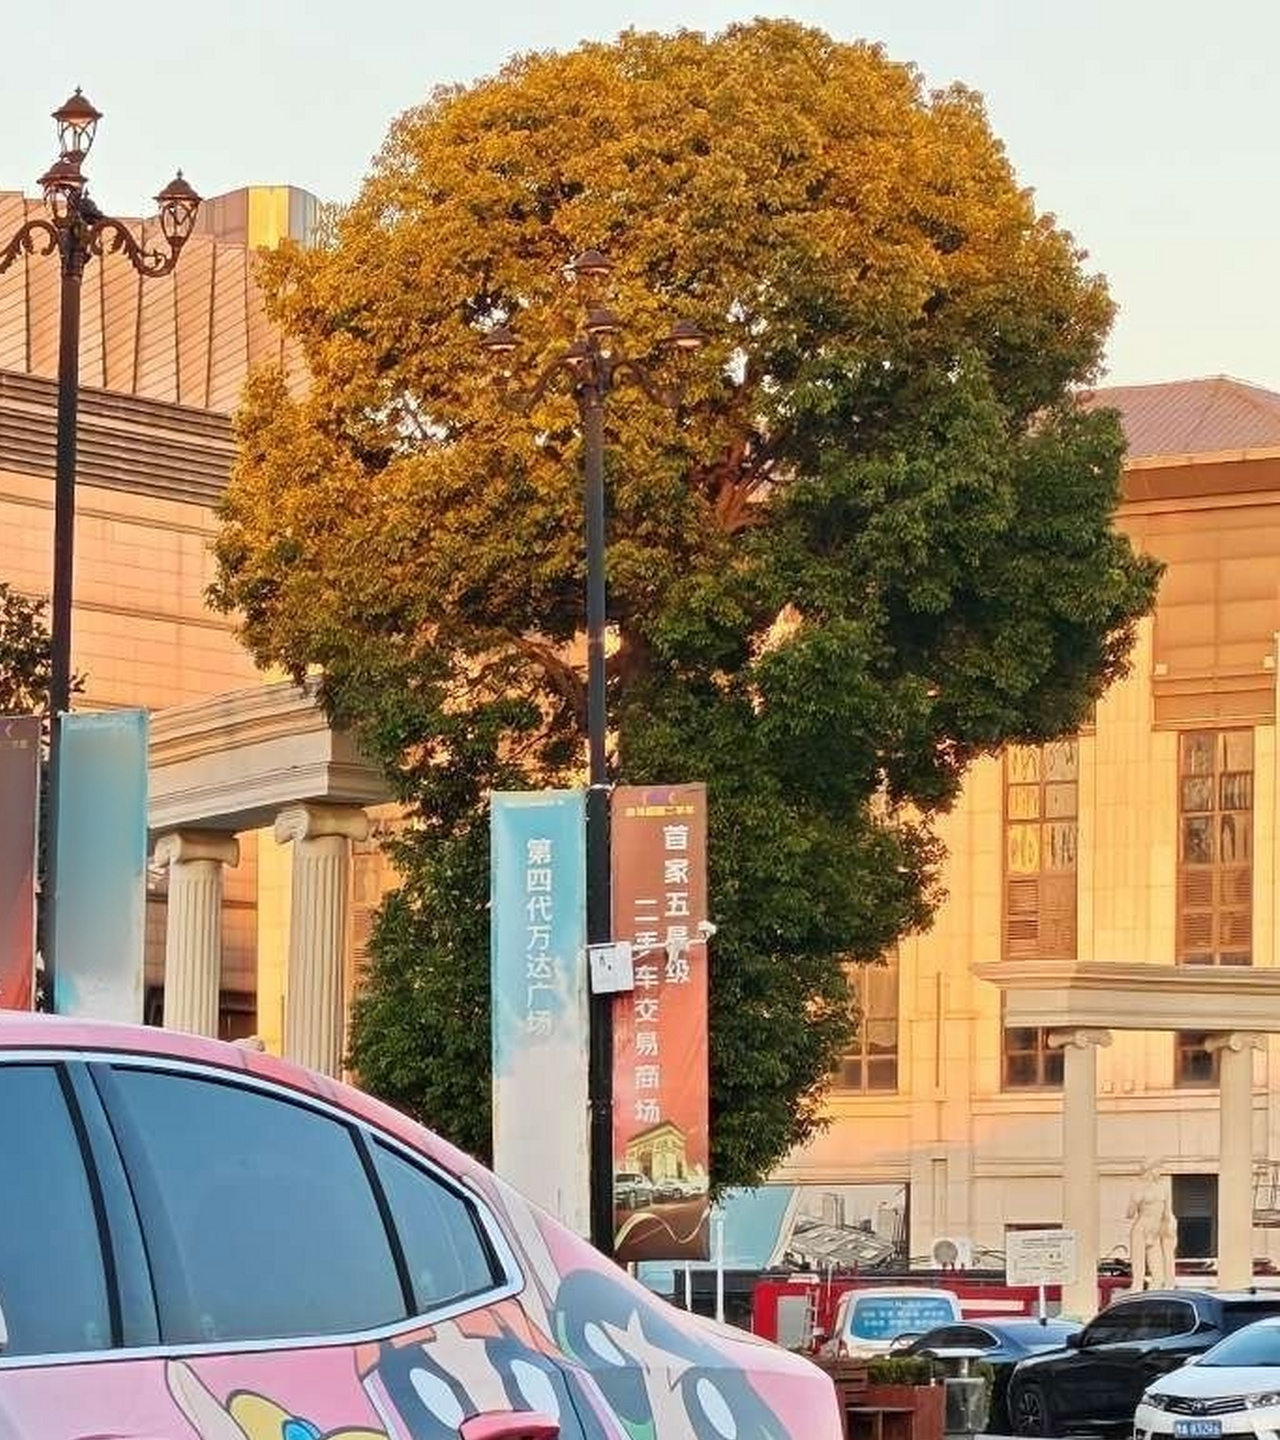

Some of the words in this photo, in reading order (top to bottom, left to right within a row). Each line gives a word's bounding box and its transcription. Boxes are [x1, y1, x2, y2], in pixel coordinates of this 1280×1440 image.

[526, 838, 552, 1036] 第四代万达广场
